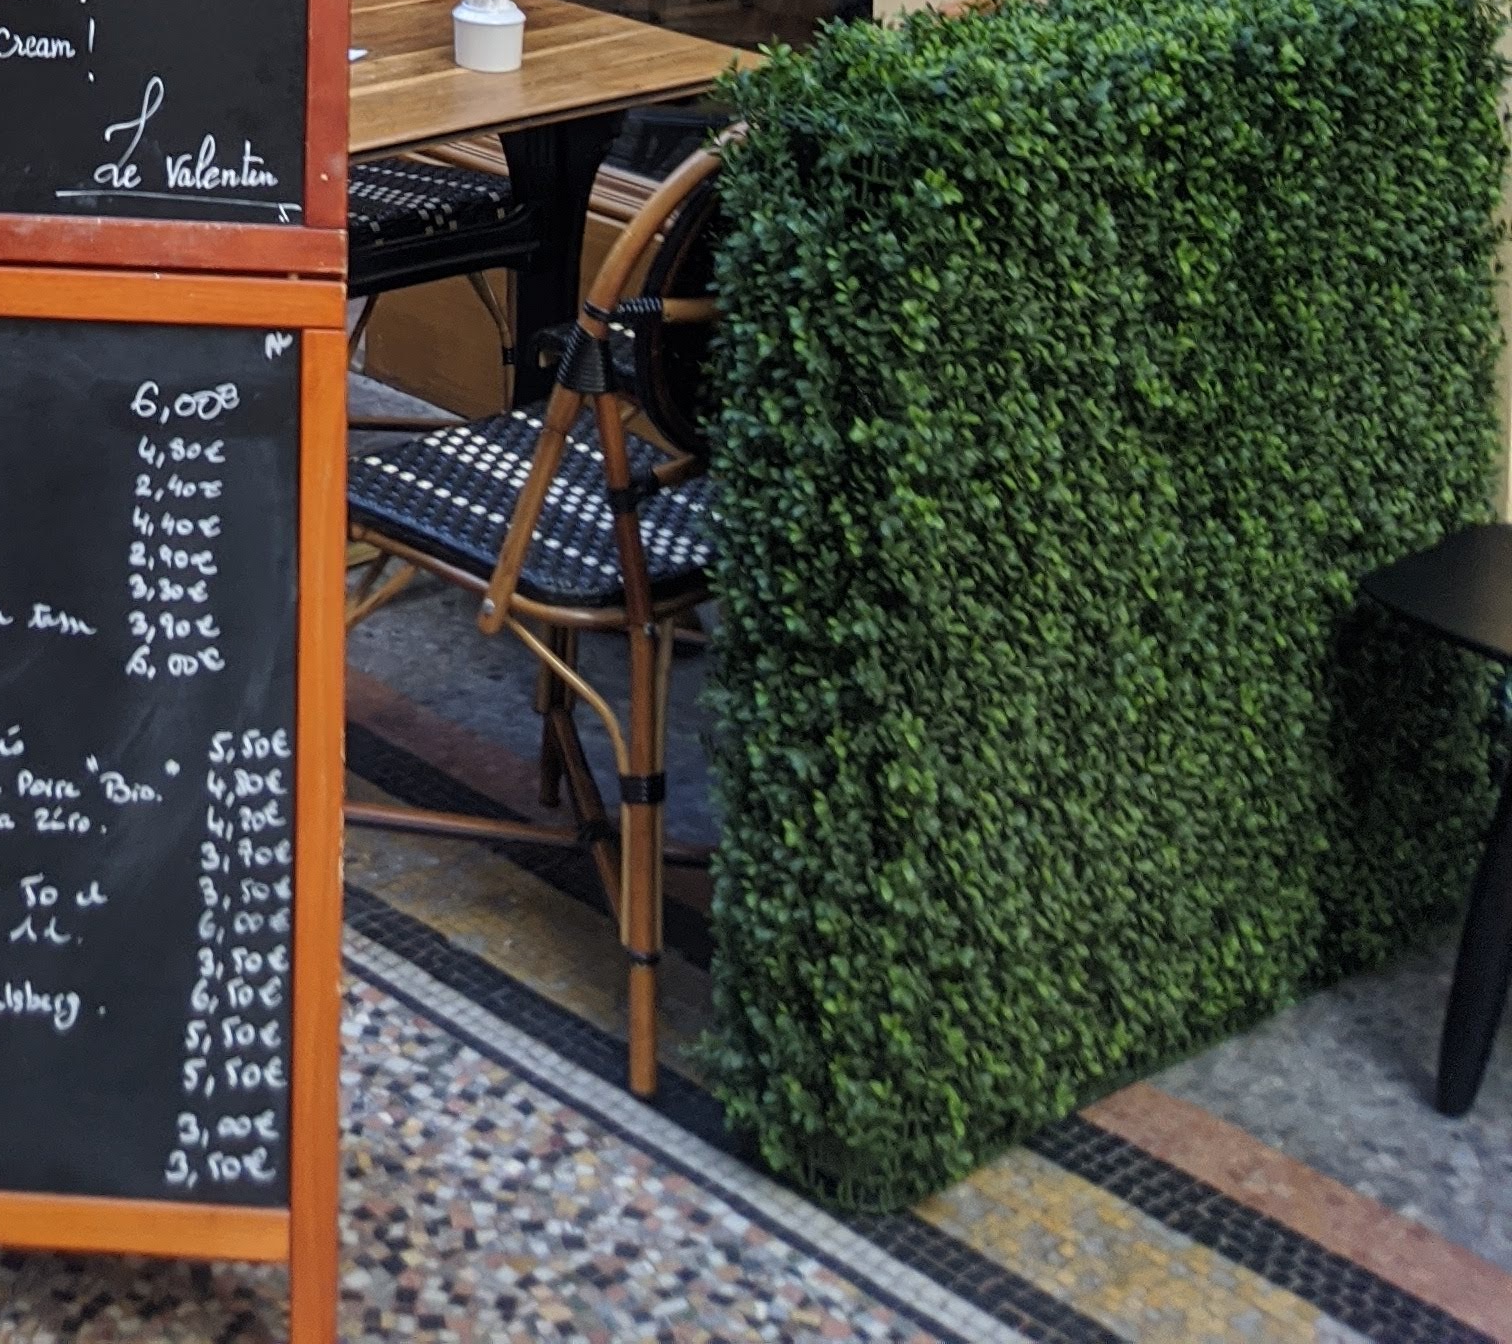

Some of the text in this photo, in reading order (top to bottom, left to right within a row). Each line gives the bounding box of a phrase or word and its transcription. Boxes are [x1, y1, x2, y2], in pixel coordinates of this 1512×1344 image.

[134, 473, 223, 502] 2,40€
[132, 505, 222, 538] 4,40€
[129, 540, 218, 576] 2,90€
[128, 610, 221, 645] 3,90€
[208, 727, 292, 764] 5,50€
[19, 873, 59, 907] 50
[197, 944, 290, 980] 3,50€
[191, 975, 284, 1014] 6,50€
[184, 1014, 282, 1055] 5,50€
[182, 1055, 288, 1098] 5,50€
[176, 1108, 281, 1149] 3,00€
[163, 1145, 277, 1190] 3,50€
